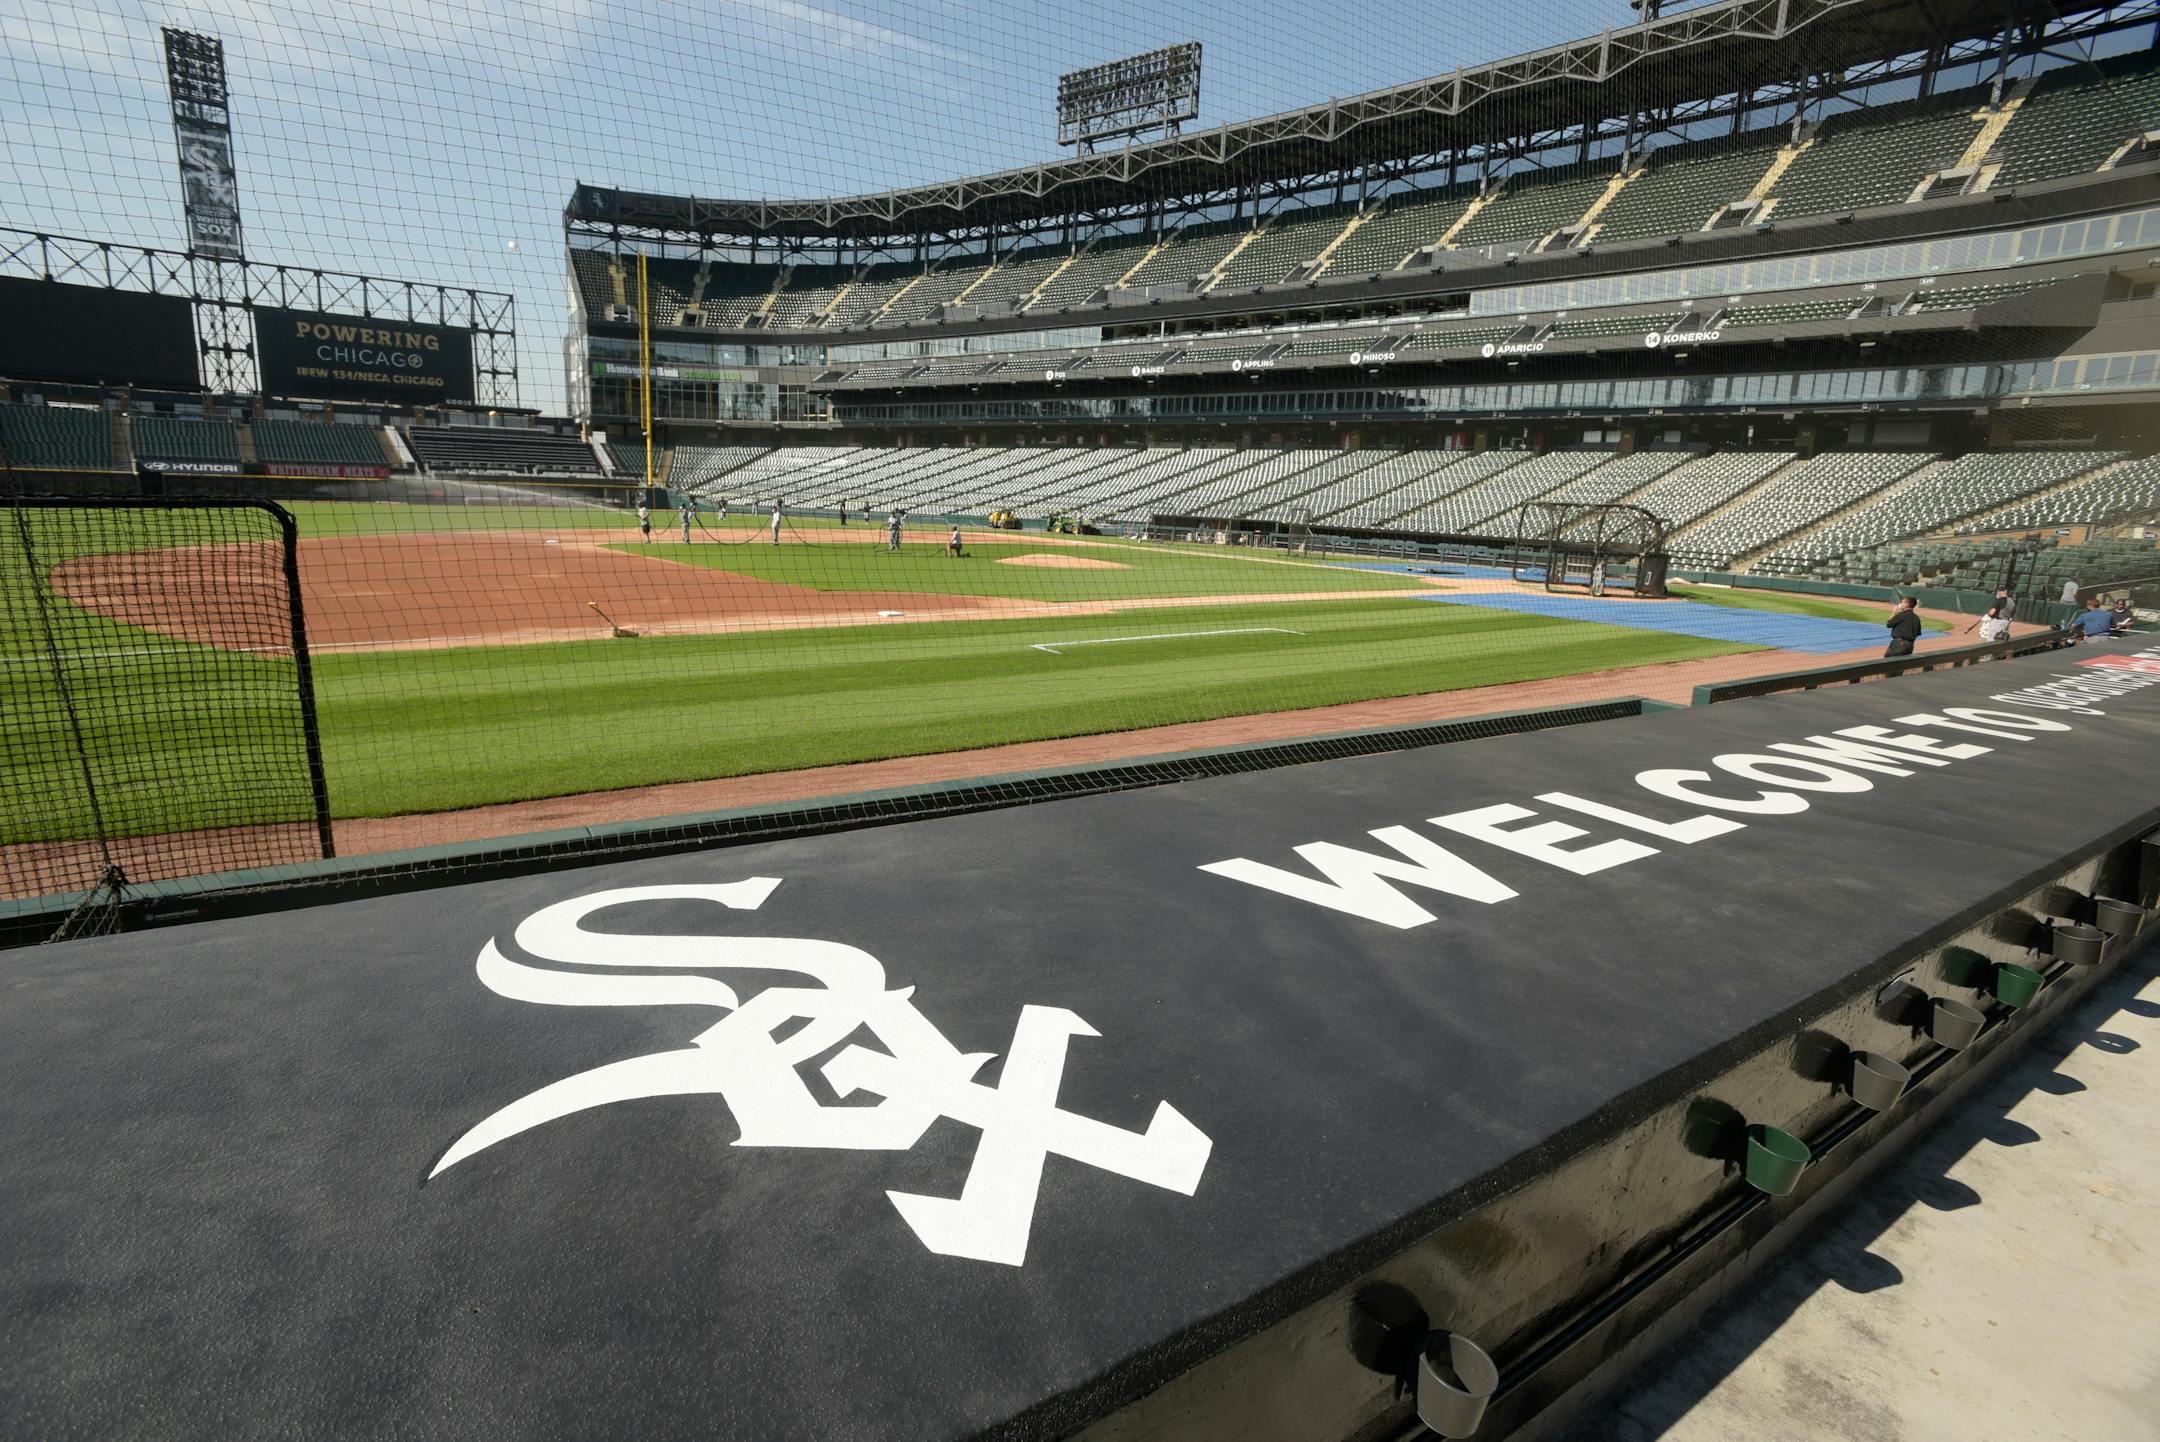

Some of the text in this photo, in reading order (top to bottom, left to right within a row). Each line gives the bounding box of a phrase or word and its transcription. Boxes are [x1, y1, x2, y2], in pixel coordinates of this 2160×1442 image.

[196, 215, 232, 226] WHITE
[197, 223, 233, 238] SOX
[296, 321, 440, 351] POWERING
[1663, 331, 1720, 344] KONERKO
[1497, 342, 1544, 354] APARICIO
[317, 345, 424, 369] CHICAGO
[1362, 352, 1396, 362] MINOSO
[606, 363, 679, 378] Huntingn Bank
[1141, 366, 1165, 374] BAINES
[1242, 359, 1274, 369] APPLING
[297, 367, 445, 387] IBEW 134/NECA CHICAGO
[172, 463, 238, 473] HYUNDAI
[269, 464, 339, 476] WHITTINGHAM
[344, 466, 375, 478] MEATS
[1197, 723, 1995, 930] WELCOME
[1891, 707, 2073, 742] TO
